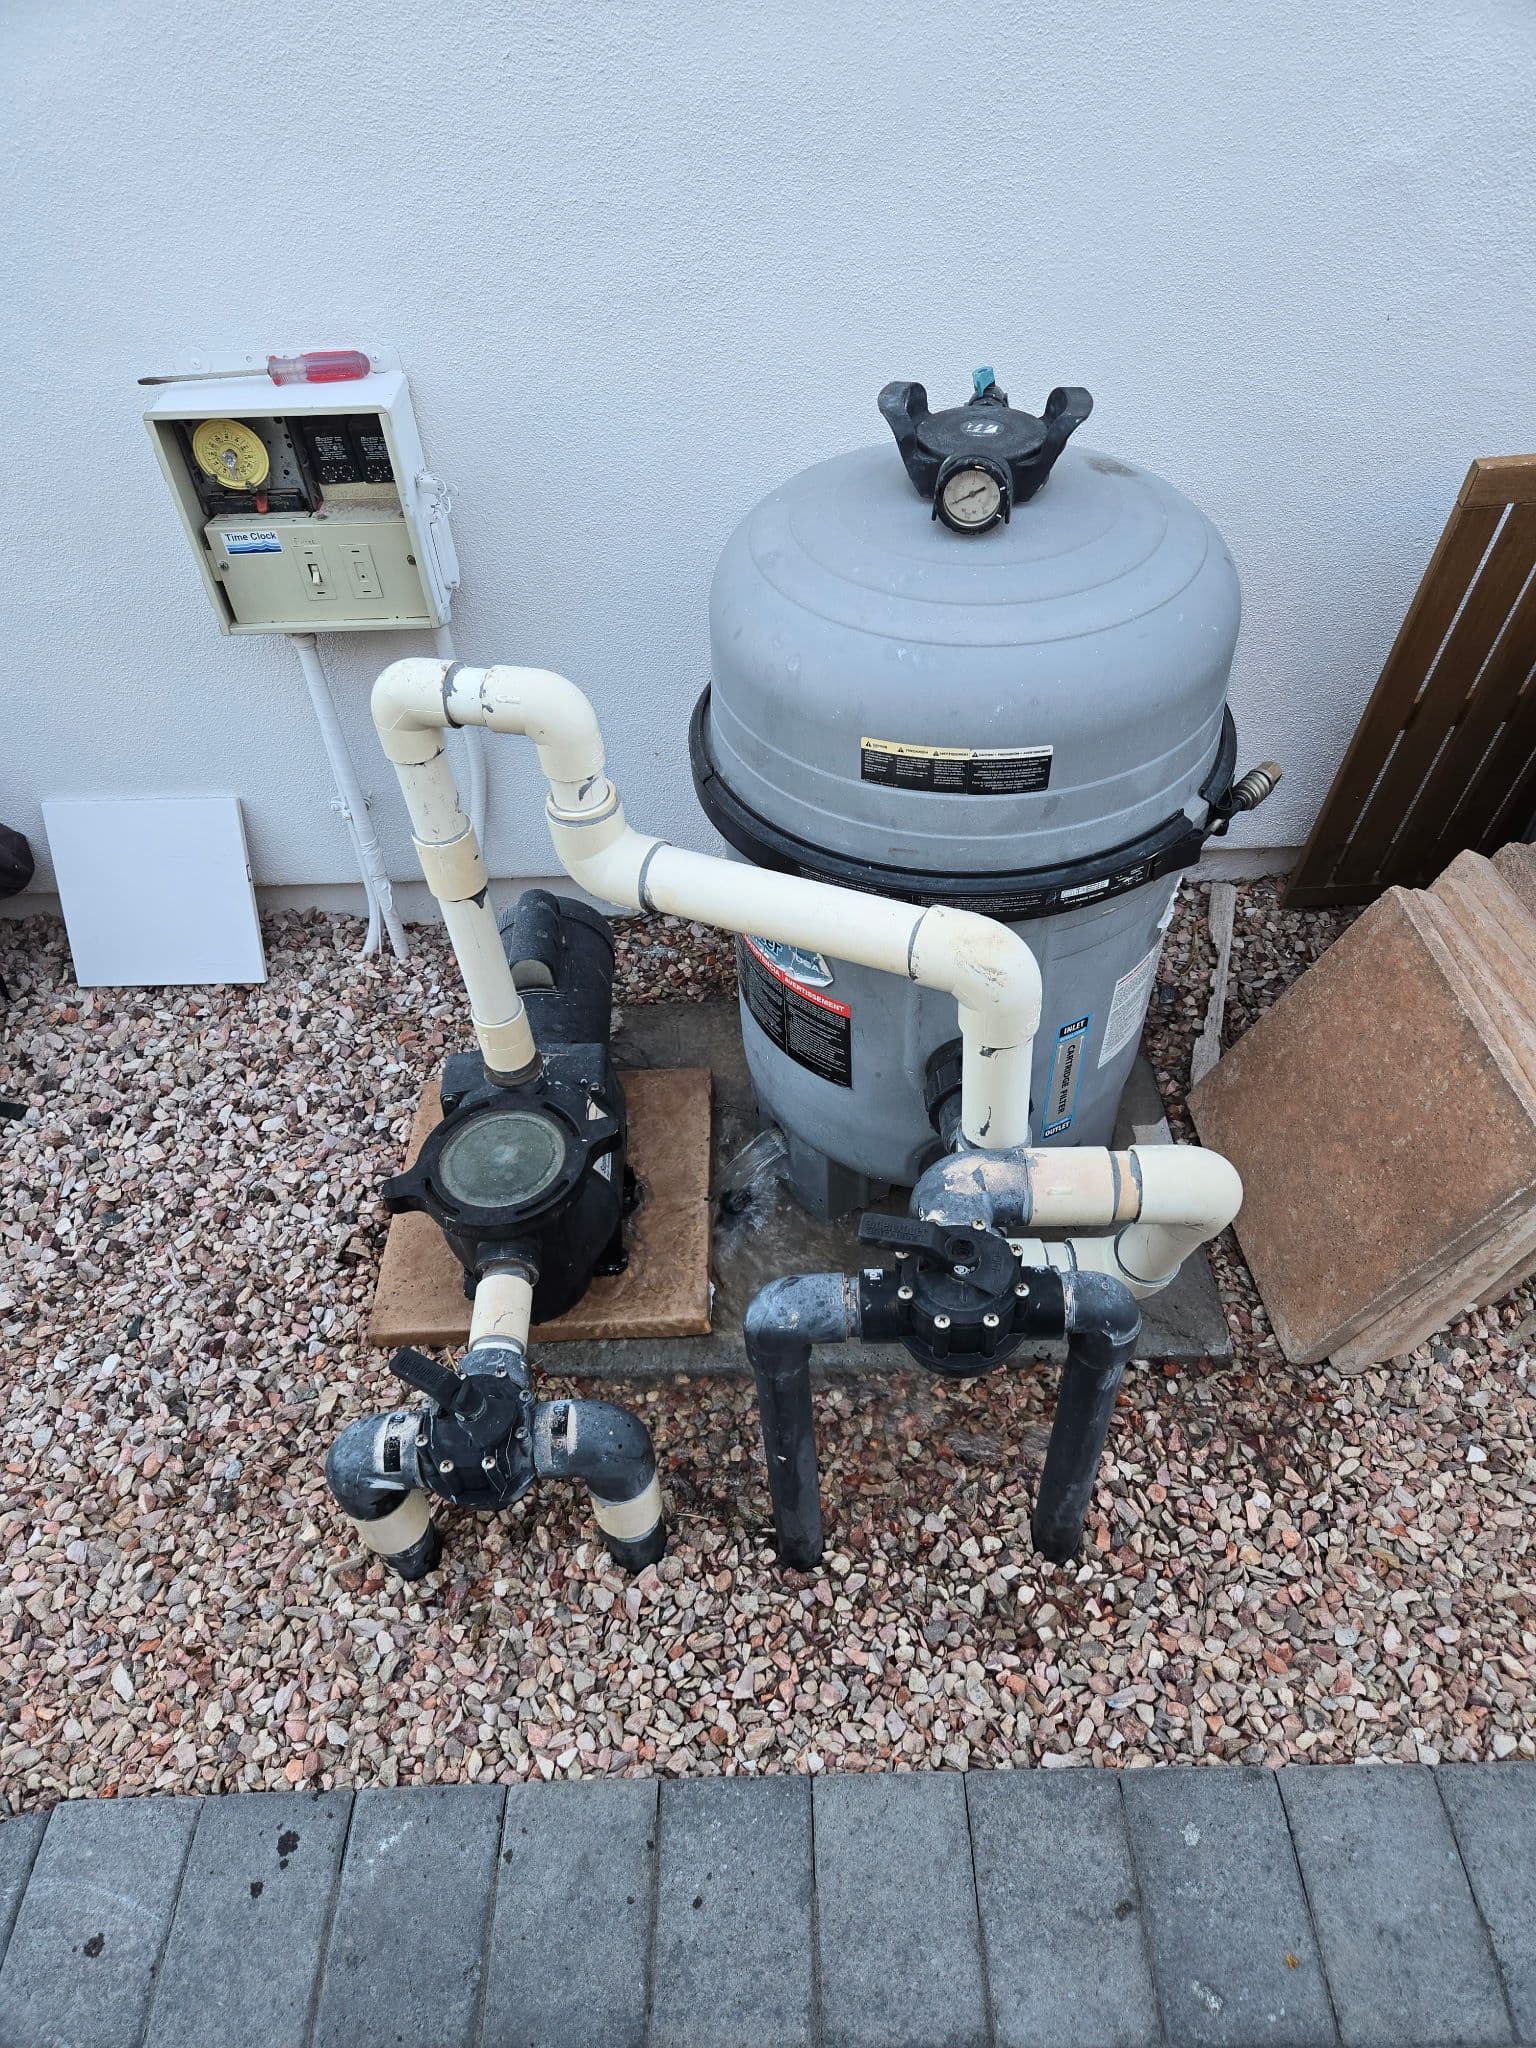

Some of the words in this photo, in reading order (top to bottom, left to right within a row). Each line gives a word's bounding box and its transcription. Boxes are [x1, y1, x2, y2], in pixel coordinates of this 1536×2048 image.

[225, 533, 249, 542] Time
[250, 531, 277, 541] Clock
[1063, 1019, 1085, 1035] INLET
[1061, 1044, 1076, 1089] CARTRIDGE
[1057, 1089, 1068, 1115] FILTER
[1044, 1120, 1071, 1137] OUTLET
